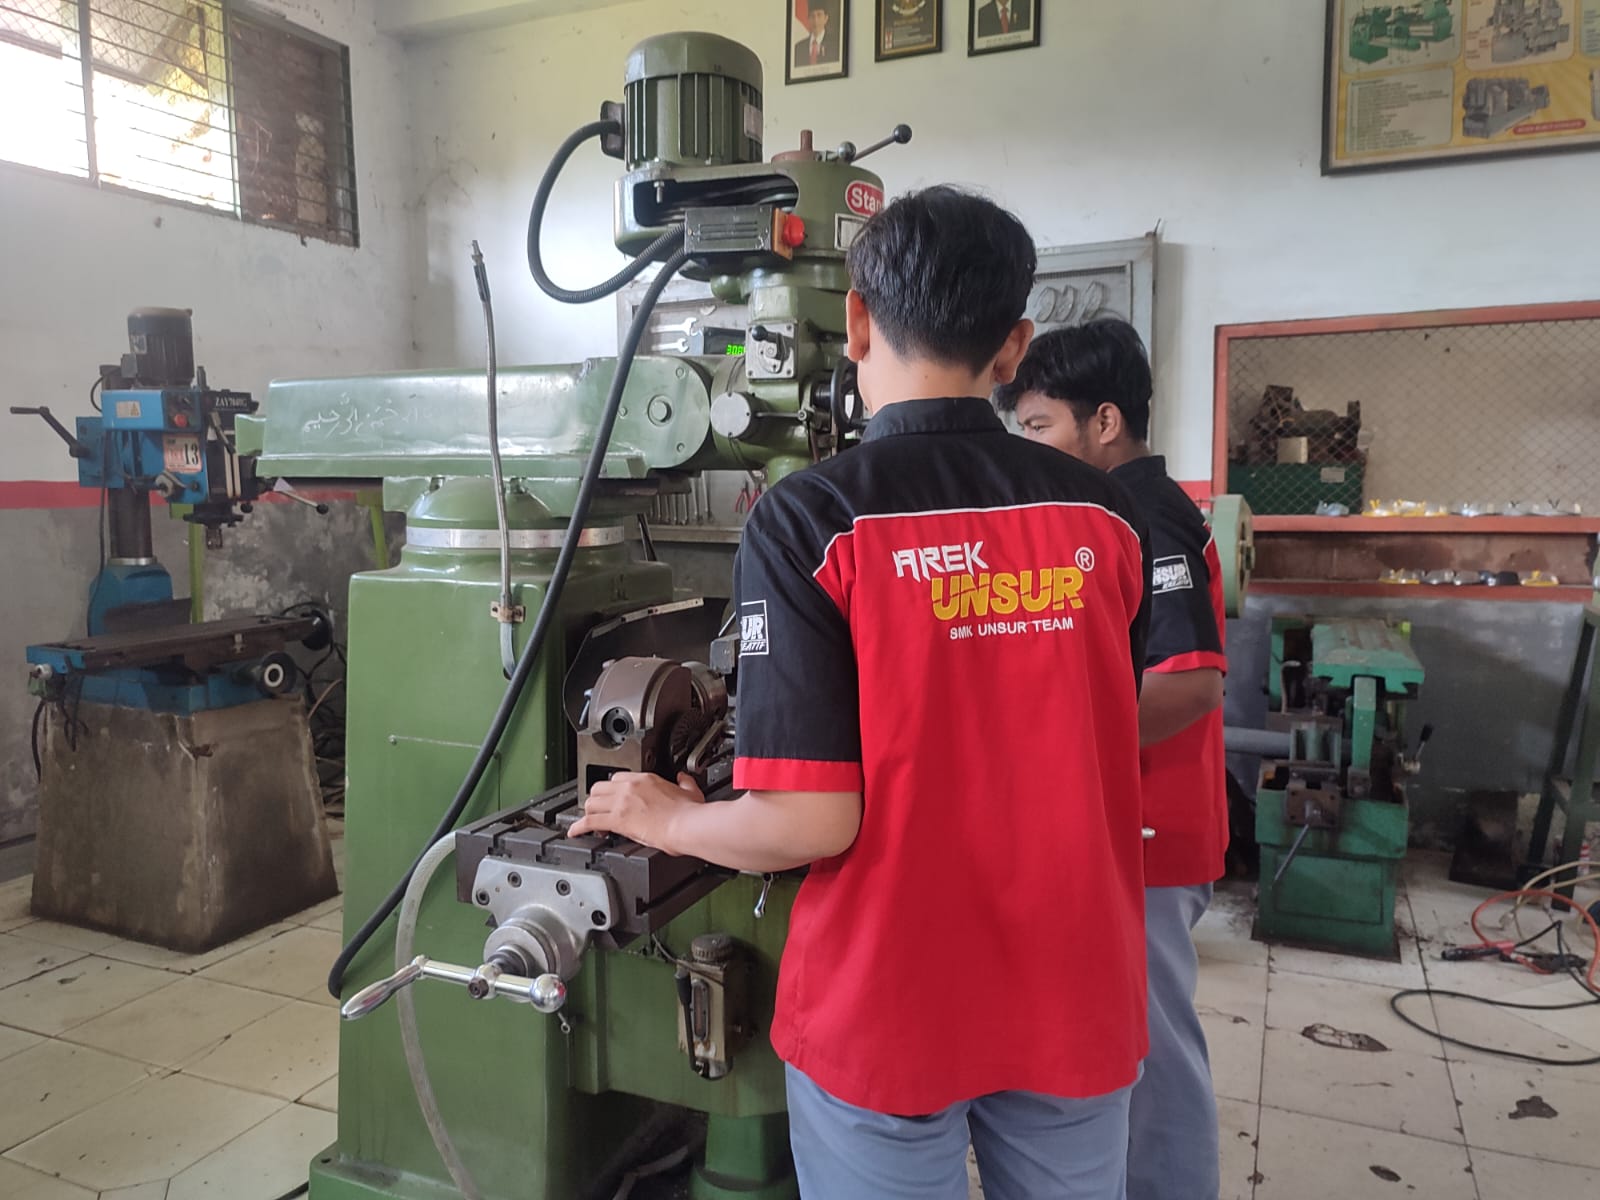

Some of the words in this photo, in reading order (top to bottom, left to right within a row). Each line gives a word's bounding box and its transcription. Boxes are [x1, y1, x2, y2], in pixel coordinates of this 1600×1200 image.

[184, 443, 199, 465] 13
[892, 541, 989, 583] AREK
[931, 566, 1085, 621] UNSUR
[740, 615, 764, 641] UR
[950, 626, 973, 640] SMK
[978, 621, 1027, 637] UNSUR
[1032, 616, 1074, 633] TEAM
